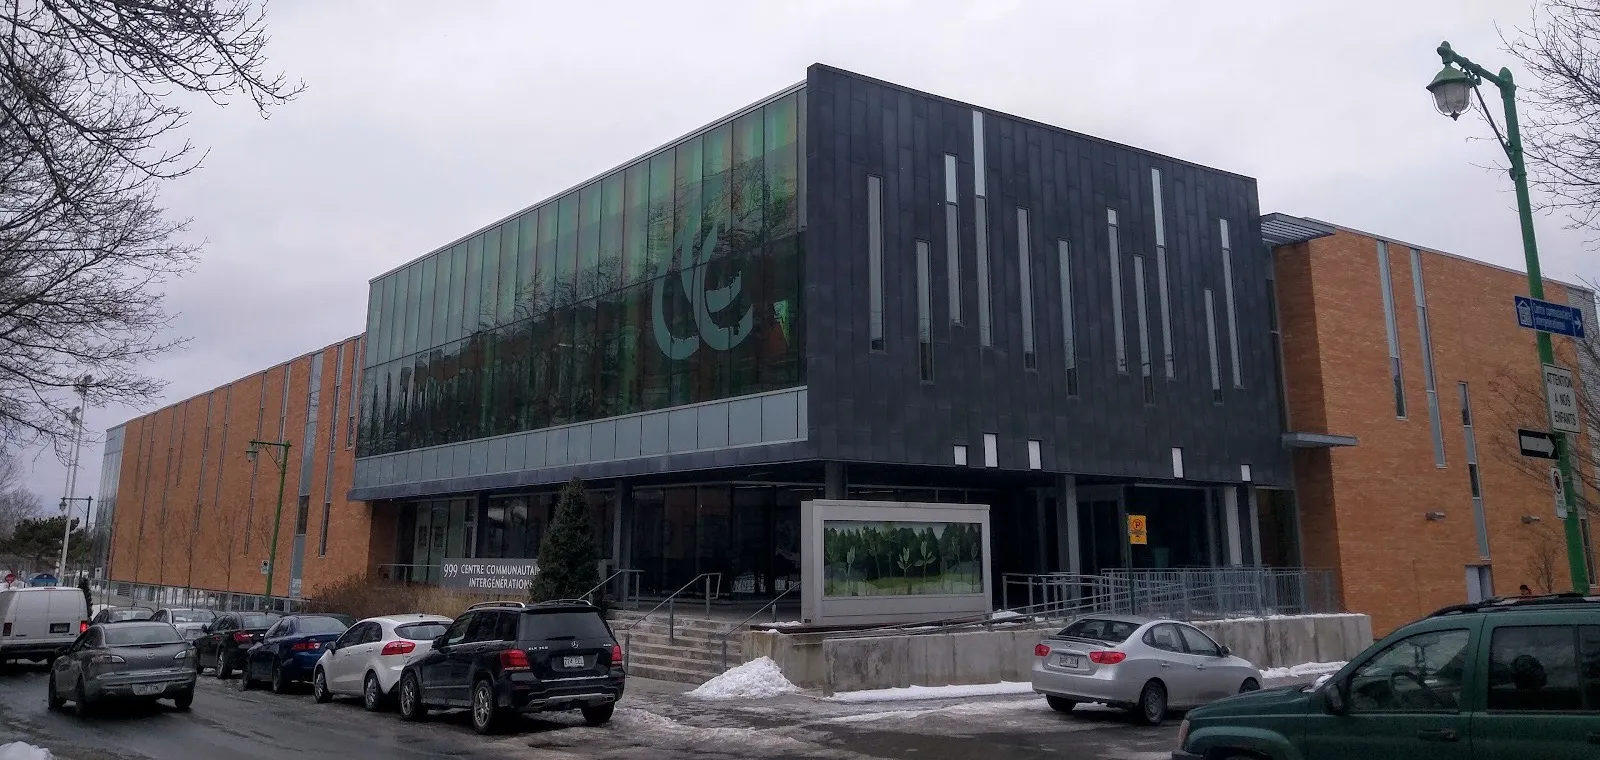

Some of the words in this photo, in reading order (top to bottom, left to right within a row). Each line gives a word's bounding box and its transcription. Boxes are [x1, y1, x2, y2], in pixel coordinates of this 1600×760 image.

[1547, 372, 1572, 388] ATTENTION
[1560, 394, 1571, 407] NOS
[1554, 410, 1576, 426] ENFANTS
[443, 563, 458, 578] 999
[460, 564, 484, 575] CENTRE
